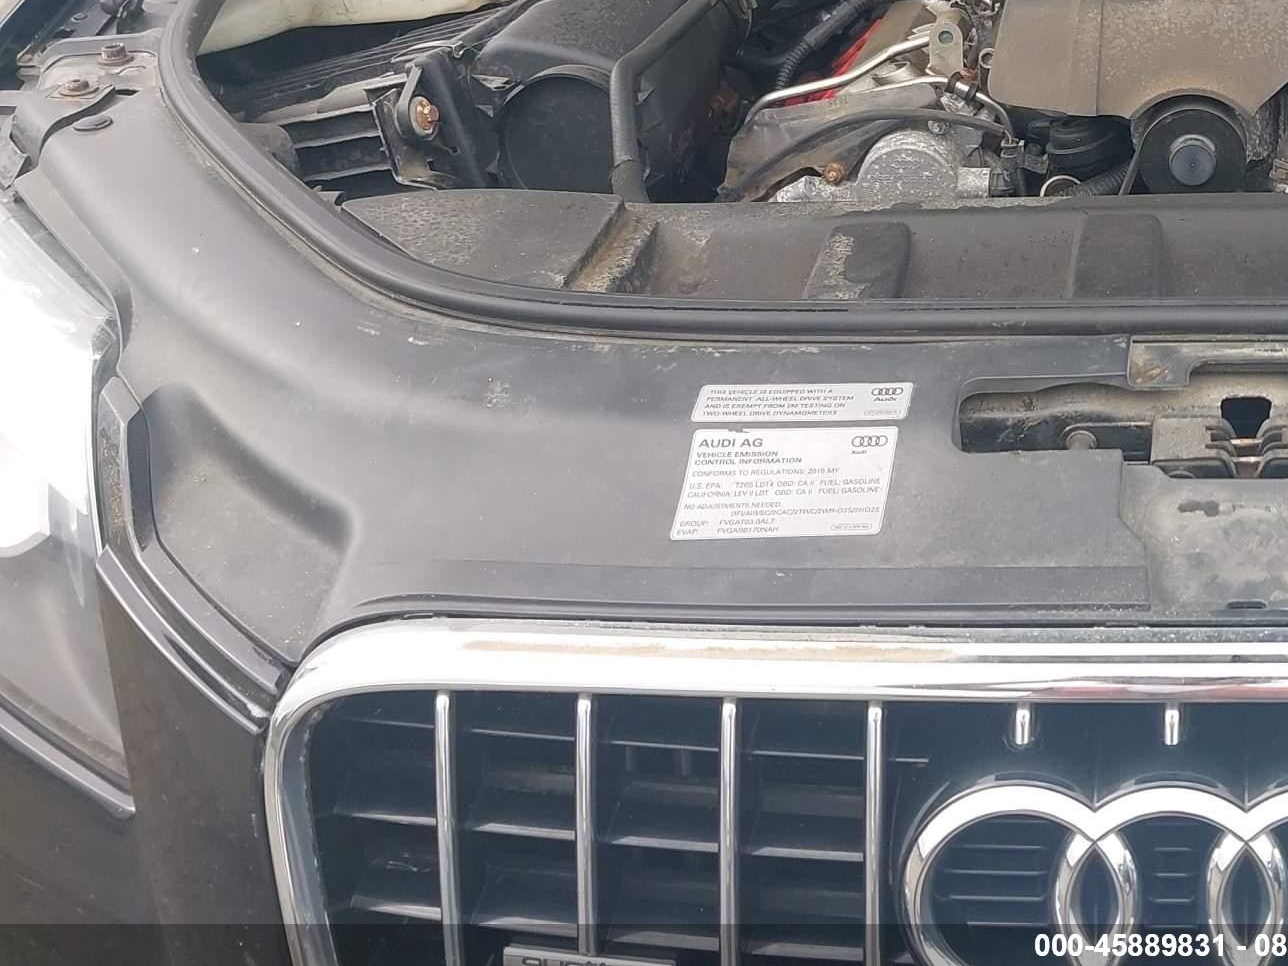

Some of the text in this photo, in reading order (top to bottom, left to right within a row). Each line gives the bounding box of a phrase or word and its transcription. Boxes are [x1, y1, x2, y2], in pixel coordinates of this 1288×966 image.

[698, 437, 764, 448] AUDI AG
[739, 457, 803, 465] INFORMATION
